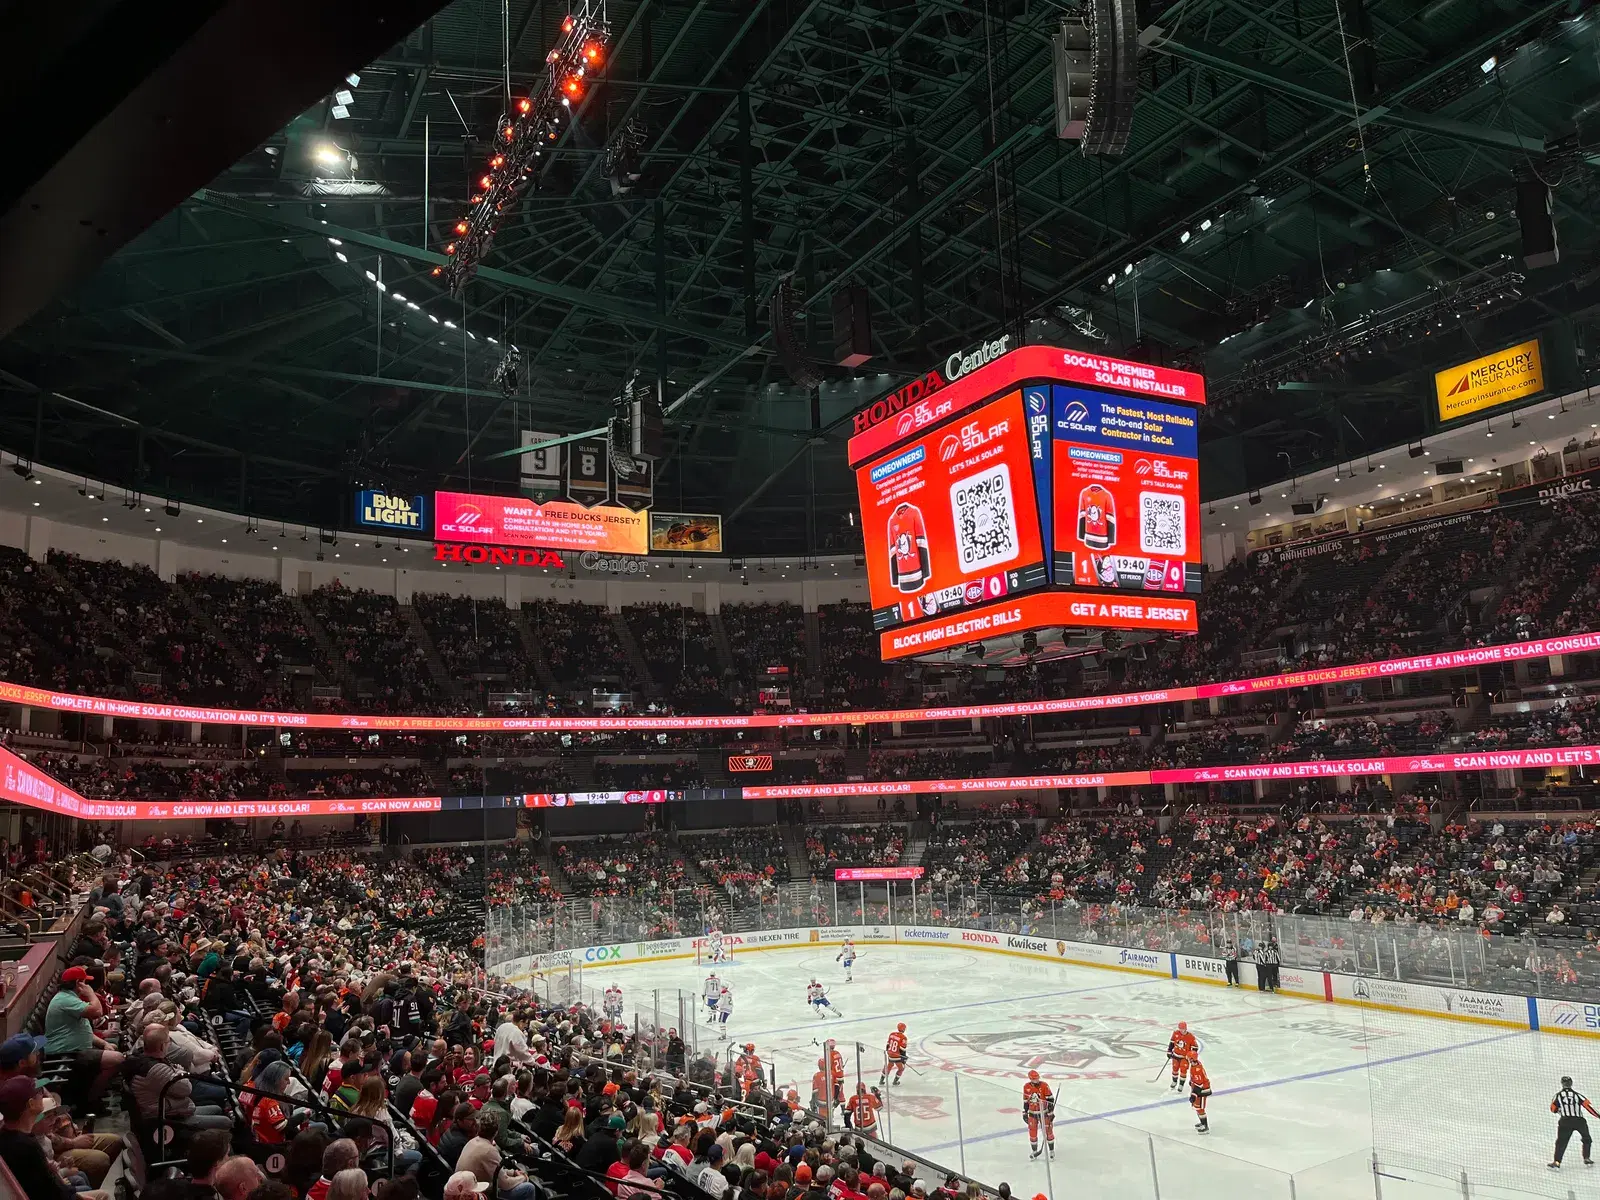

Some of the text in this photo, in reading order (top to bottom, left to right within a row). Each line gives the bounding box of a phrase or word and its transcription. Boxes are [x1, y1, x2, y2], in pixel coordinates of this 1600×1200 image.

[1064, 354, 1155, 380] SOCAL'S PREMIER
[1471, 352, 1532, 380] MERCURY
[1472, 362, 1534, 388] INSURANCE
[852, 334, 1010, 434] HONDA Center
[1096, 372, 1186, 396] SOLAR INSTALLER
[1446, 378, 1536, 410] MercuryInsurance.com
[914, 402, 929, 416] OC
[915, 401, 952, 426] SOLAR
[1101, 404, 1194, 426] The Fastest, Most Reliable
[961, 422, 978, 437] OC
[1070, 423, 1096, 432] SOLAR
[1101, 418, 1163, 432] end-to-end Solar
[963, 420, 1009, 451] SOLAR
[1031, 416, 1042, 458] SOLAR
[1102, 428, 1174, 445] Contractor in SoCal.
[872, 448, 923, 480] HOMEOWNERS!
[965, 453, 980, 469] TALK
[981, 445, 1004, 462] SOLAR!
[1070, 450, 1120, 462] HOMEOWNERS!
[582, 454, 596, 476] 8
[1154, 460, 1167, 469] OC
[1154, 468, 1188, 480] SOLAR
[365, 507, 416, 526] LIGHT
[504, 507, 641, 525] WANT A FREE DUCKS JERSEY?
[442, 524, 493, 535] OC SOLAR
[1376, 515, 1471, 542] WELCOME TO HONDA CENTER
[1318, 540, 1342, 556] DUCKS
[434, 543, 648, 572] HONDA Center
[1081, 559, 1180, 580] 1 19:40 0
[908, 606, 914, 617] 1
[941, 586, 962, 600] 19:40
[990, 577, 1000, 595] 0
[1070, 603, 1189, 621] GET A FREE JERSEY
[894, 609, 1021, 649] BLOCK HIGH ELECTRIC BILLS
[1252, 679, 1274, 688] WANT
[1276, 678, 1283, 686] A
[1285, 675, 1305, 684] FREE
[1308, 671, 1336, 681] DUCKS
[1340, 666, 1377, 678] JERSEY?
[1380, 658, 1432, 672] COMPLETE
[1435, 656, 1450, 666] AN
[1453, 649, 1501, 663] IN-HOME
[1504, 644, 1543, 657] SOLAR
[23, 691, 51, 703] JERSEY?
[52, 696, 92, 709] COMPLETE
[94, 701, 105, 711] AN
[107, 703, 140, 714] IN-HOME
[142, 706, 172, 717] SOLAR
[174, 709, 236, 720] CONSULTATION
[238, 713, 258, 722] AND
[260, 714, 274, 723] IT'S
[277, 715, 306, 724] YOURS!
[1454, 750, 1592, 767] SCAN NOW AND LET'S
[1224, 762, 1385, 778] SCAN NOW AND LET'S TALK SOLAR!
[362, 800, 432, 810] SCAN NOW AND
[533, 796, 538, 805] 1
[654, 792, 660, 800] 0
[115, 806, 136, 815] SOLAR!
[173, 806, 193, 815] SCAN
[195, 805, 212, 815] NOW
[214, 805, 232, 814] AND
[234, 805, 255, 814] LET'S
[258, 804, 276, 813] TALK
[278, 804, 310, 813] SOLAR!
[758, 932, 799, 942] NEXEN TIRE
[904, 929, 950, 939] ticketmaster
[962, 933, 999, 944] HONDA
[1008, 936, 1047, 952] Kwikset
[586, 946, 621, 962] COX
[1118, 949, 1158, 964] FAIRMONT
[710, 982, 718, 992] 71
[1370, 983, 1407, 993] CONCORDIA
[1371, 990, 1408, 1000] UNIVERSITY
[410, 1002, 418, 1010] 91
[1459, 1002, 1479, 1010] RESORT
